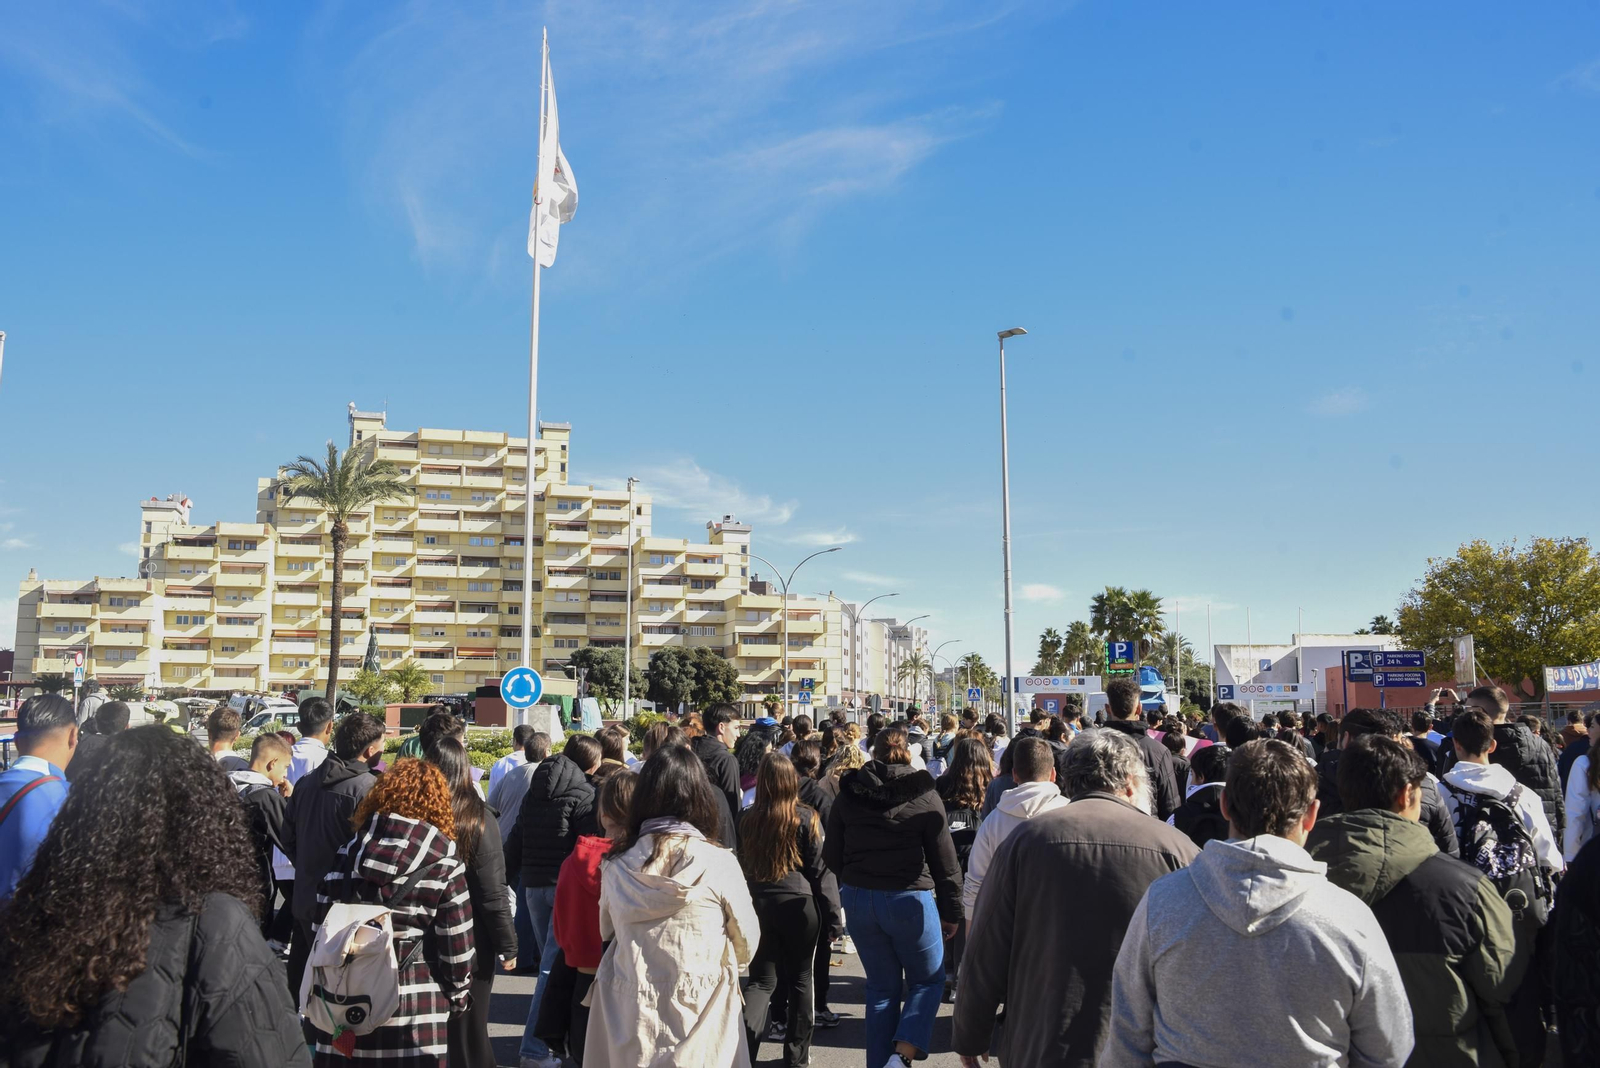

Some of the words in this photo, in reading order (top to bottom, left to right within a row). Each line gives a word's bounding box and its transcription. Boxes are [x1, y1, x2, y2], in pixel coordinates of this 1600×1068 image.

[1115, 643, 1127, 658] P
[1350, 653, 1363, 667] P
[1375, 655, 1382, 664] P
[1376, 675, 1382, 684] P
[1220, 687, 1228, 698] P
[1047, 702, 1055, 711] P
